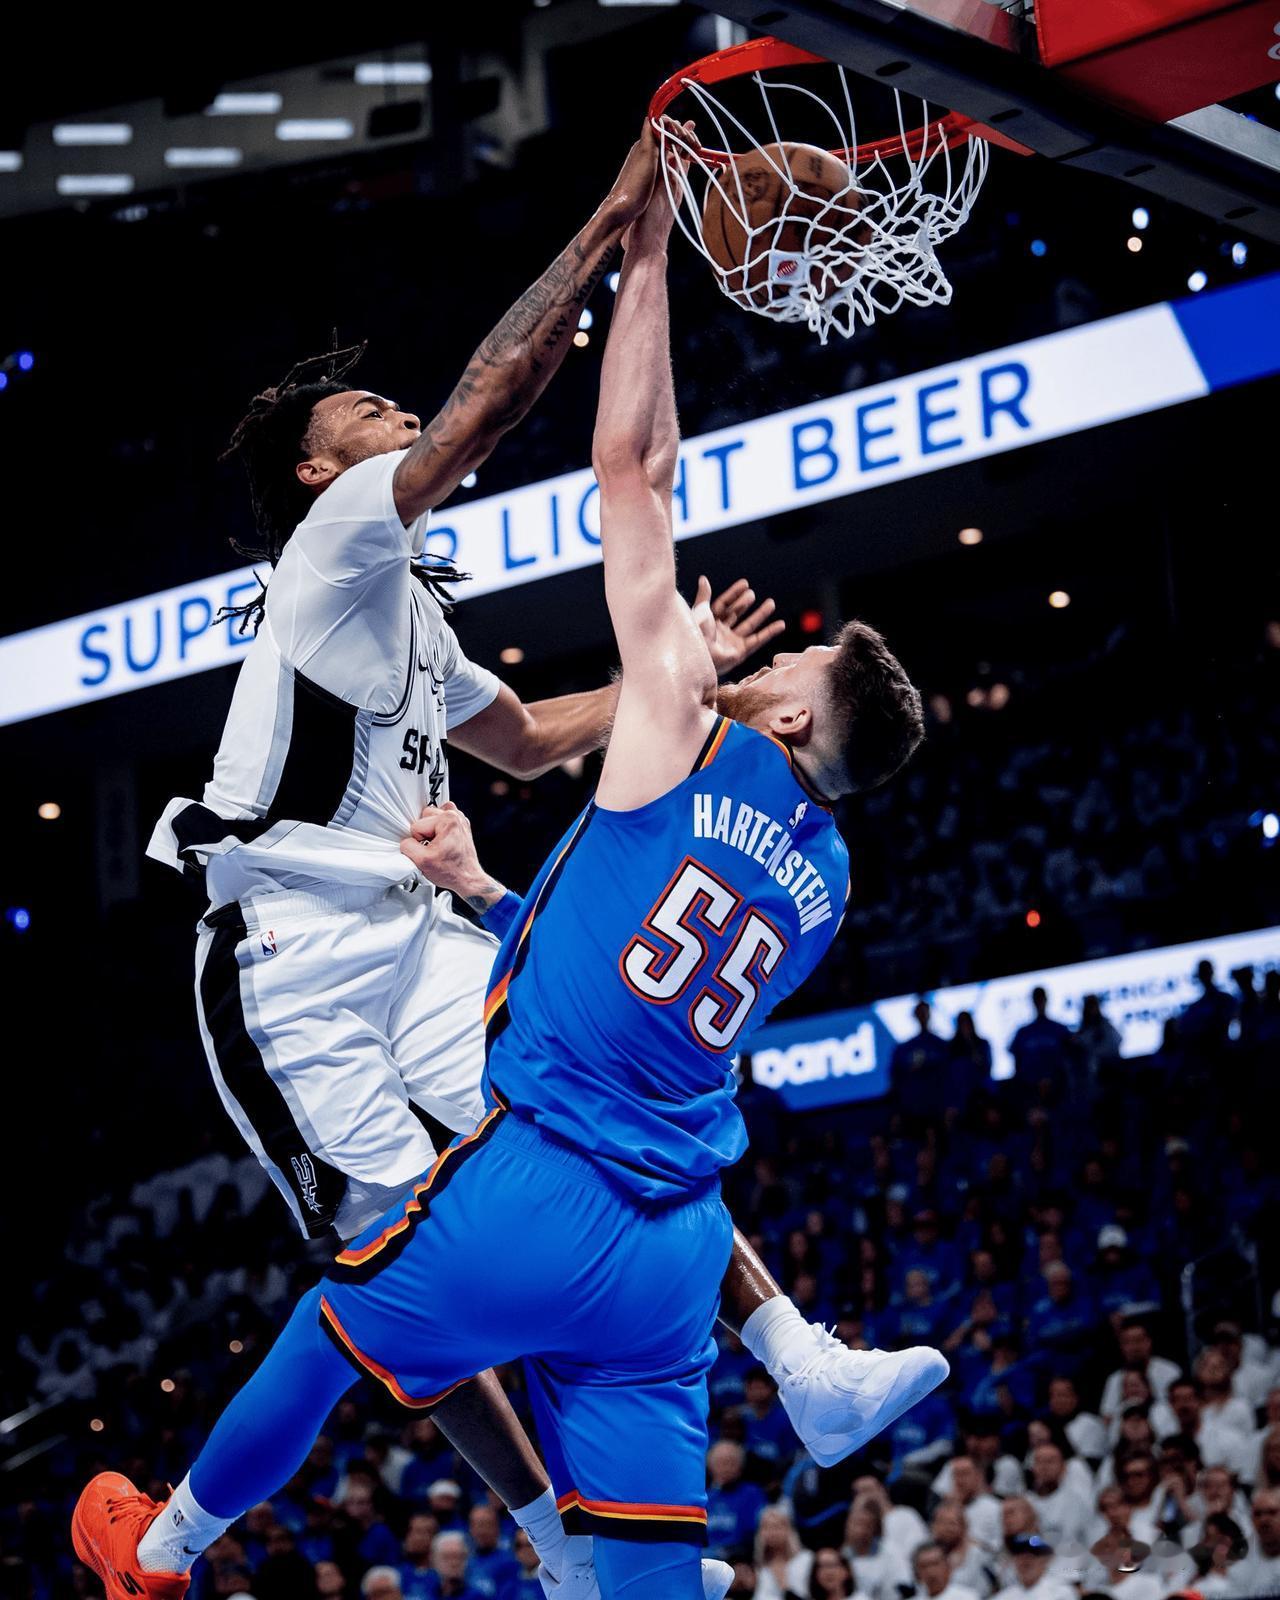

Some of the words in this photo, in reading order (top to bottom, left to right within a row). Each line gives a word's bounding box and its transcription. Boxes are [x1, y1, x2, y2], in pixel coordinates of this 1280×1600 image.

[792, 362, 1031, 489] BEER
[693, 793, 834, 937] HARTENSTEIN
[618, 854, 790, 1055] 55
